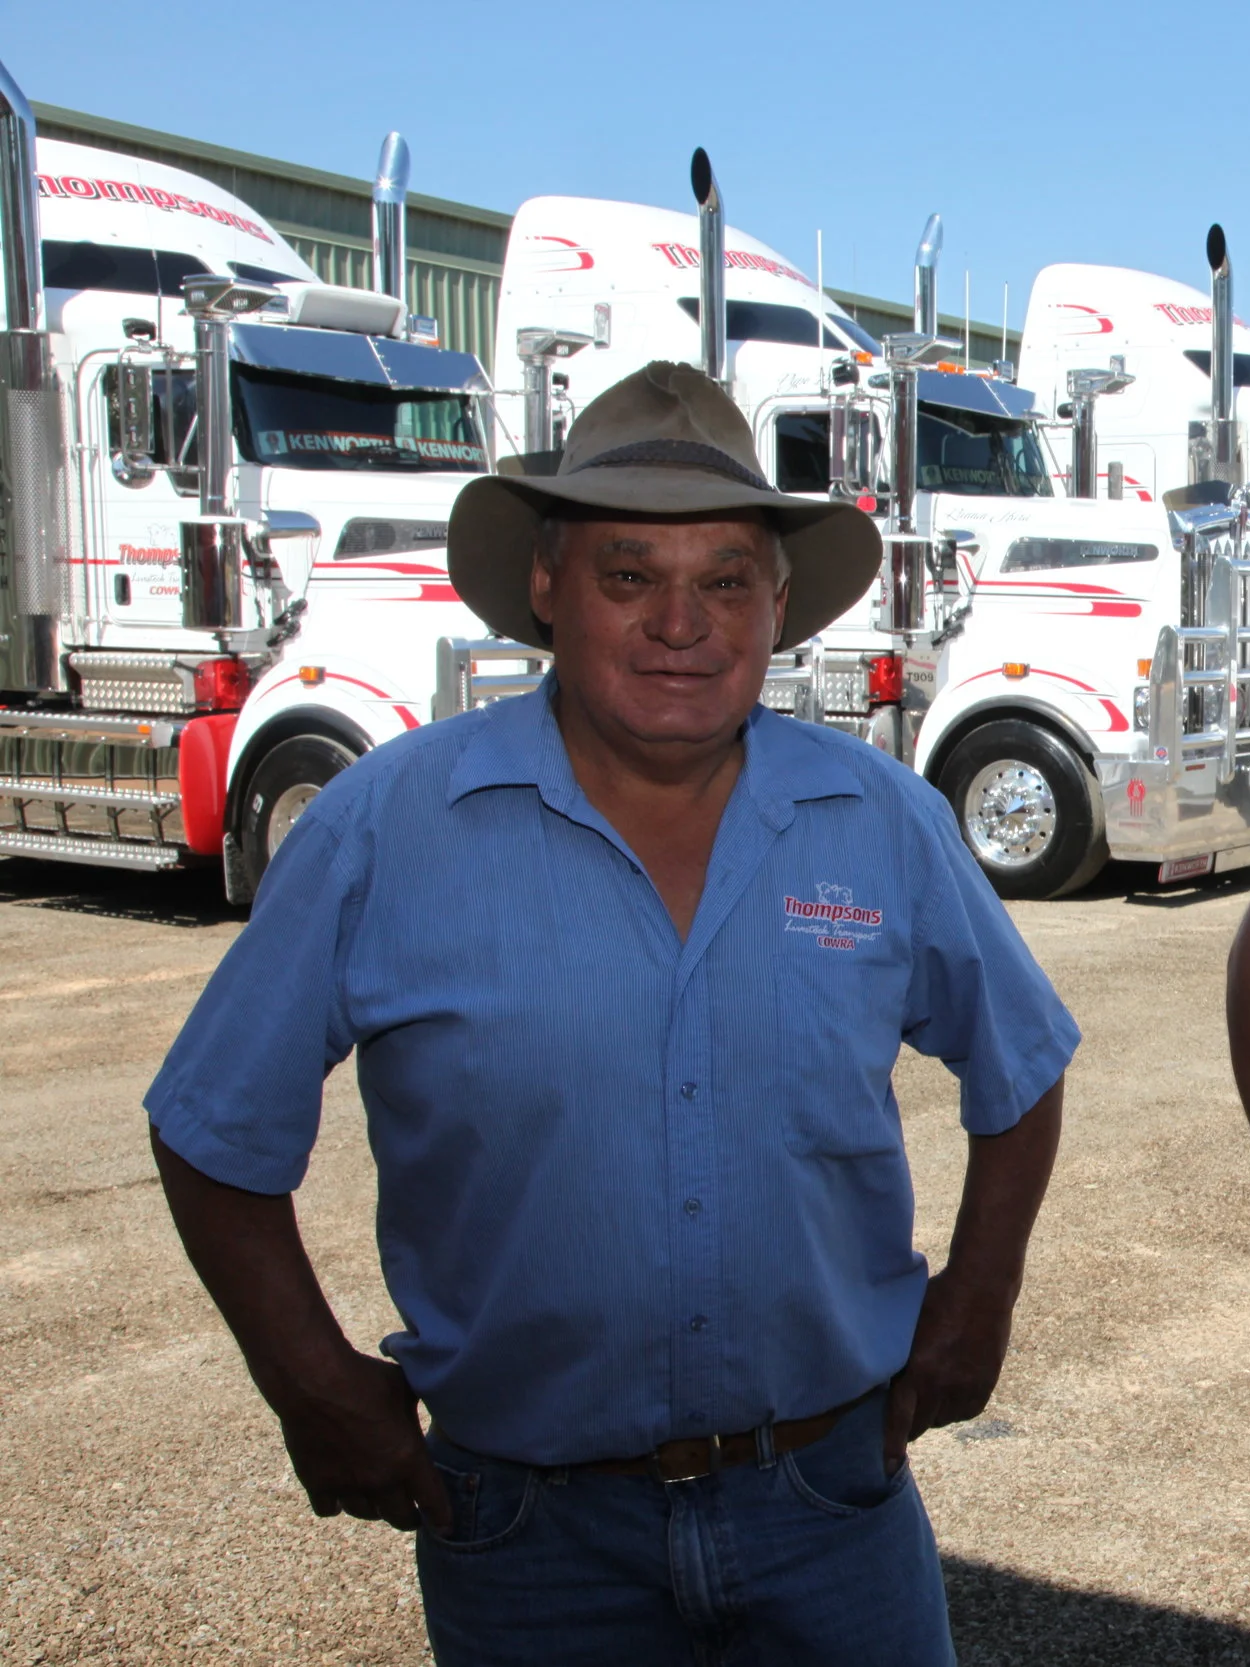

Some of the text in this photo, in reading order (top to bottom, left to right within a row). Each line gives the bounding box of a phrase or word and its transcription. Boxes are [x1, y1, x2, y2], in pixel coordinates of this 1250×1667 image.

[907, 671, 934, 682] T909
[784, 895, 882, 926] Thompsons
[832, 921, 882, 943] Transport
[816, 934, 856, 951] COWRA
